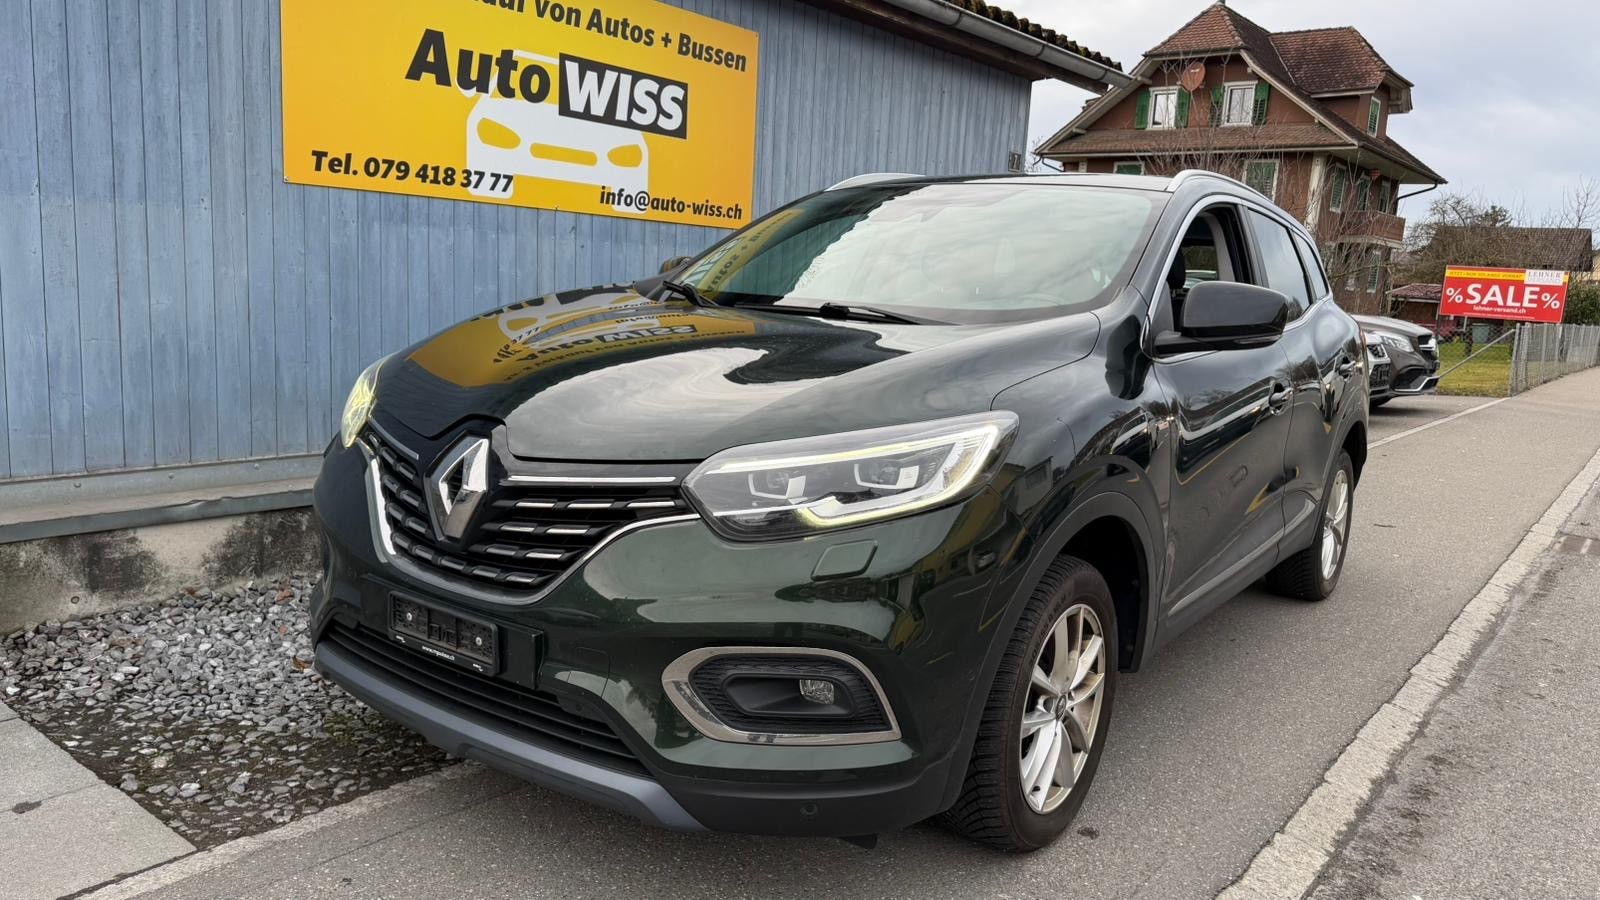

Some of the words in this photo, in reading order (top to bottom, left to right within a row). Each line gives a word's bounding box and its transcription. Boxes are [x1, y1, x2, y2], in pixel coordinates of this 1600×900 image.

[535, 0, 582, 28] von
[586, 8, 655, 47] Autos
[661, 32, 672, 48] +
[677, 33, 747, 72] Bussen
[405, 28, 551, 104] Auto
[564, 60, 686, 131] WISS
[311, 150, 358, 176] Tel.
[363, 157, 411, 181] 079
[415, 163, 456, 186] 418
[460, 168, 485, 189] 37
[489, 172, 514, 193] 77
[600, 185, 743, 220] info@auto-wiss.ch
